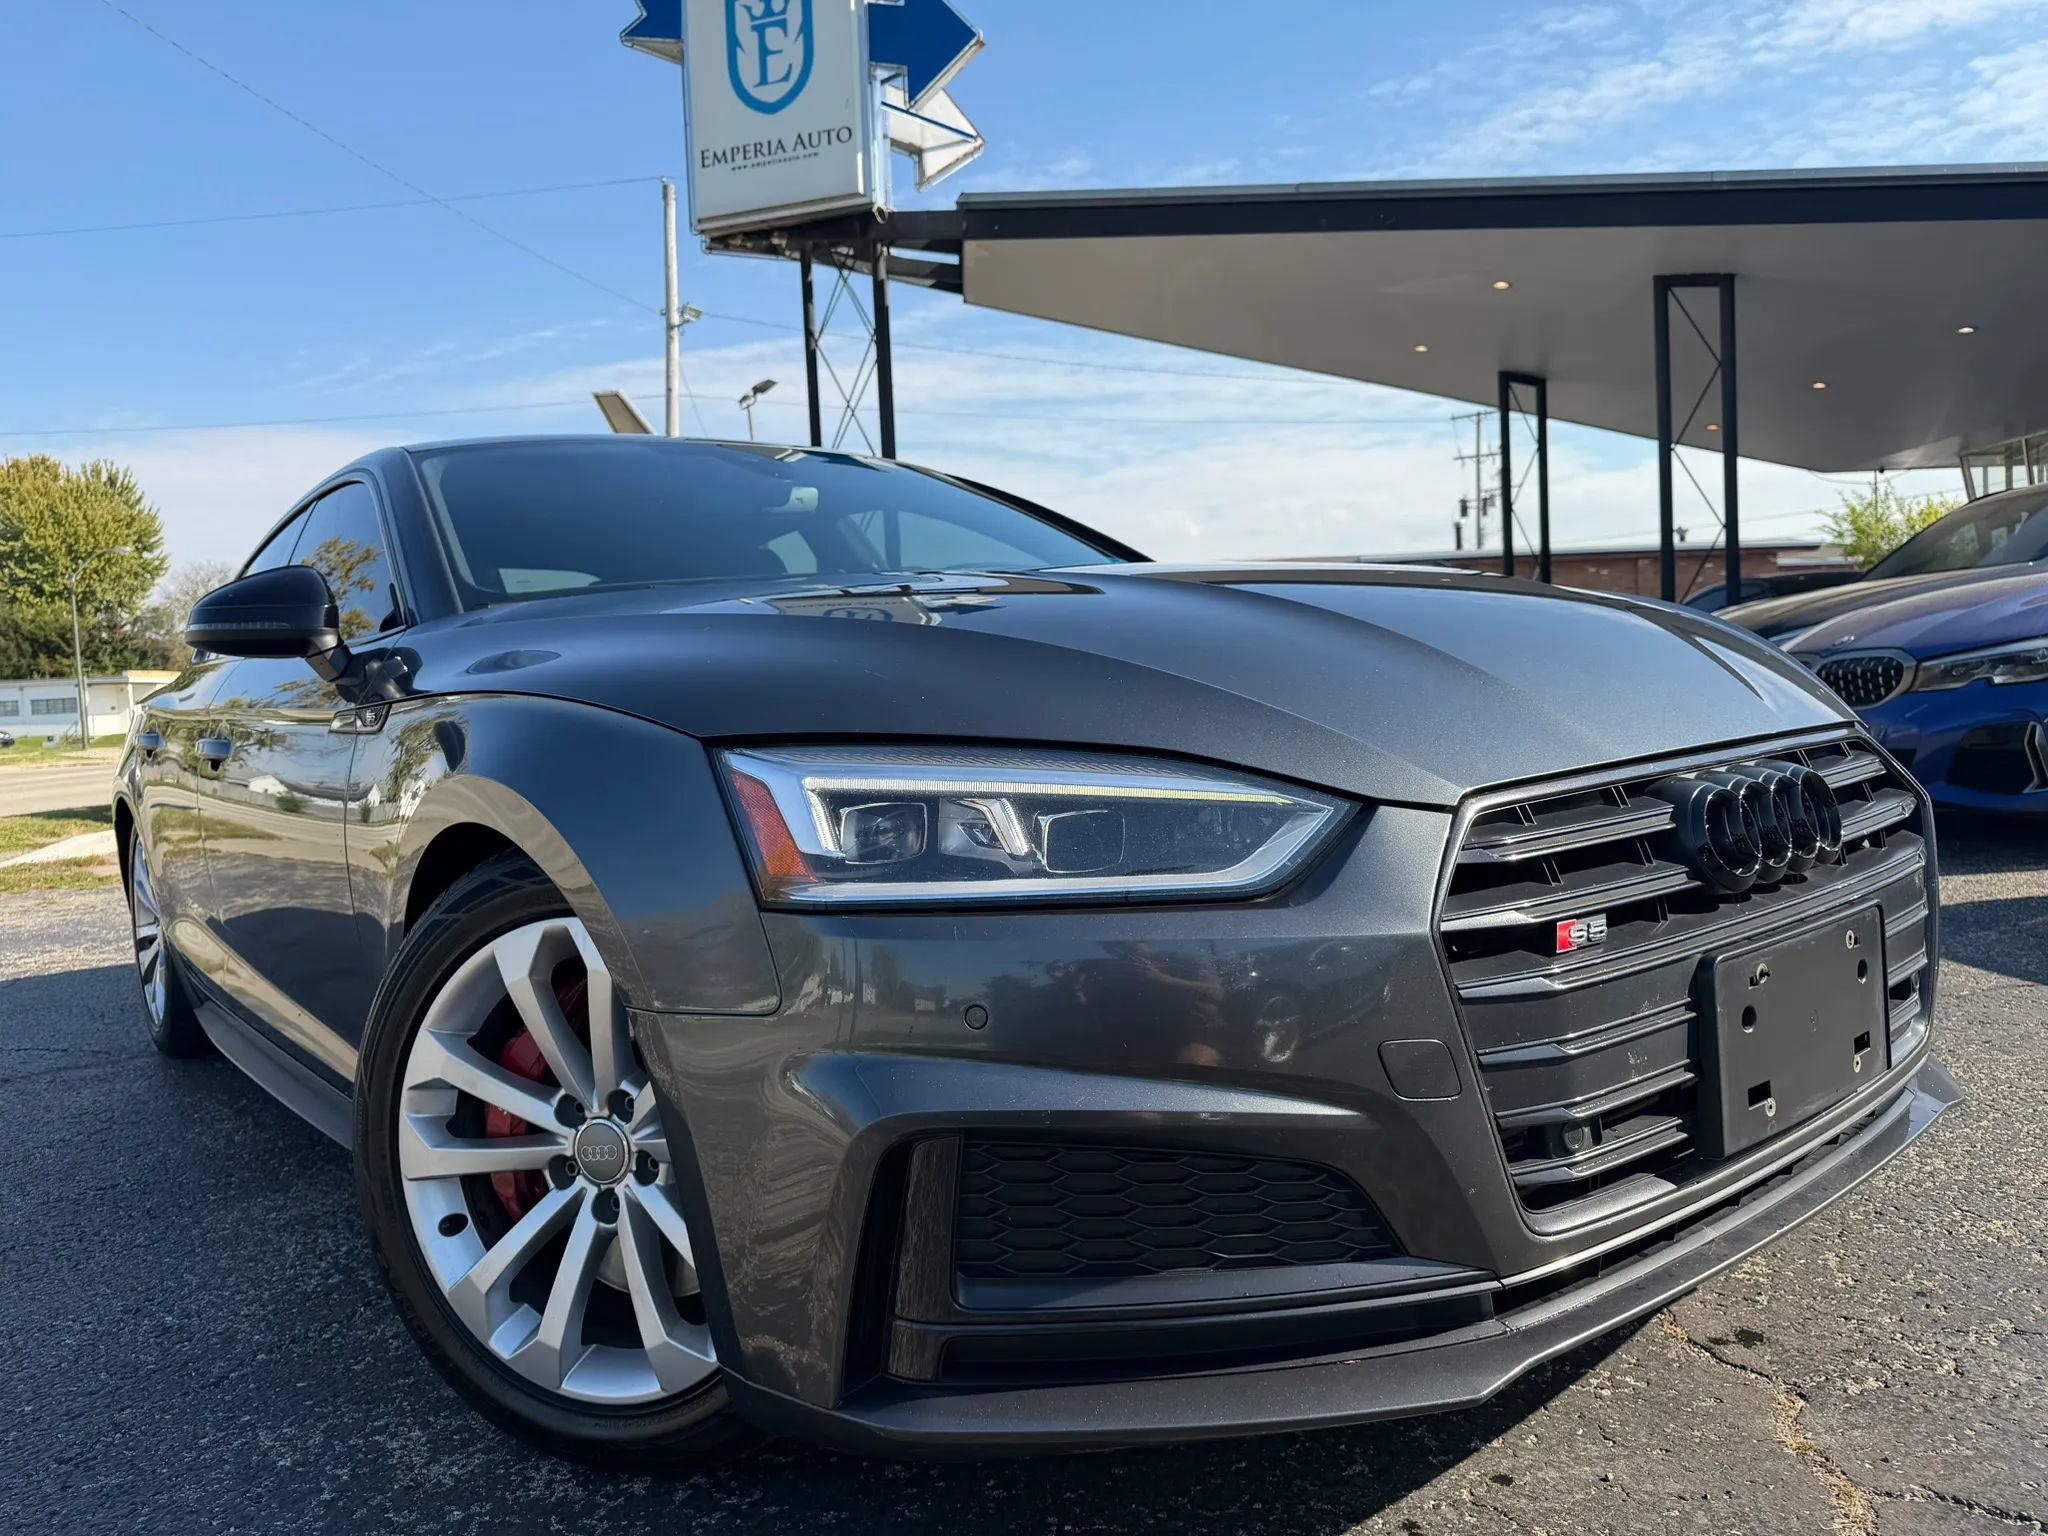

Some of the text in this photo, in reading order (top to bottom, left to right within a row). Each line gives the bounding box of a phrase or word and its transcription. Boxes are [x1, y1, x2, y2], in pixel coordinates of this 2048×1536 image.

[700, 126, 853, 169] EMPERIA AUTO
[1568, 919, 1608, 947] S5
